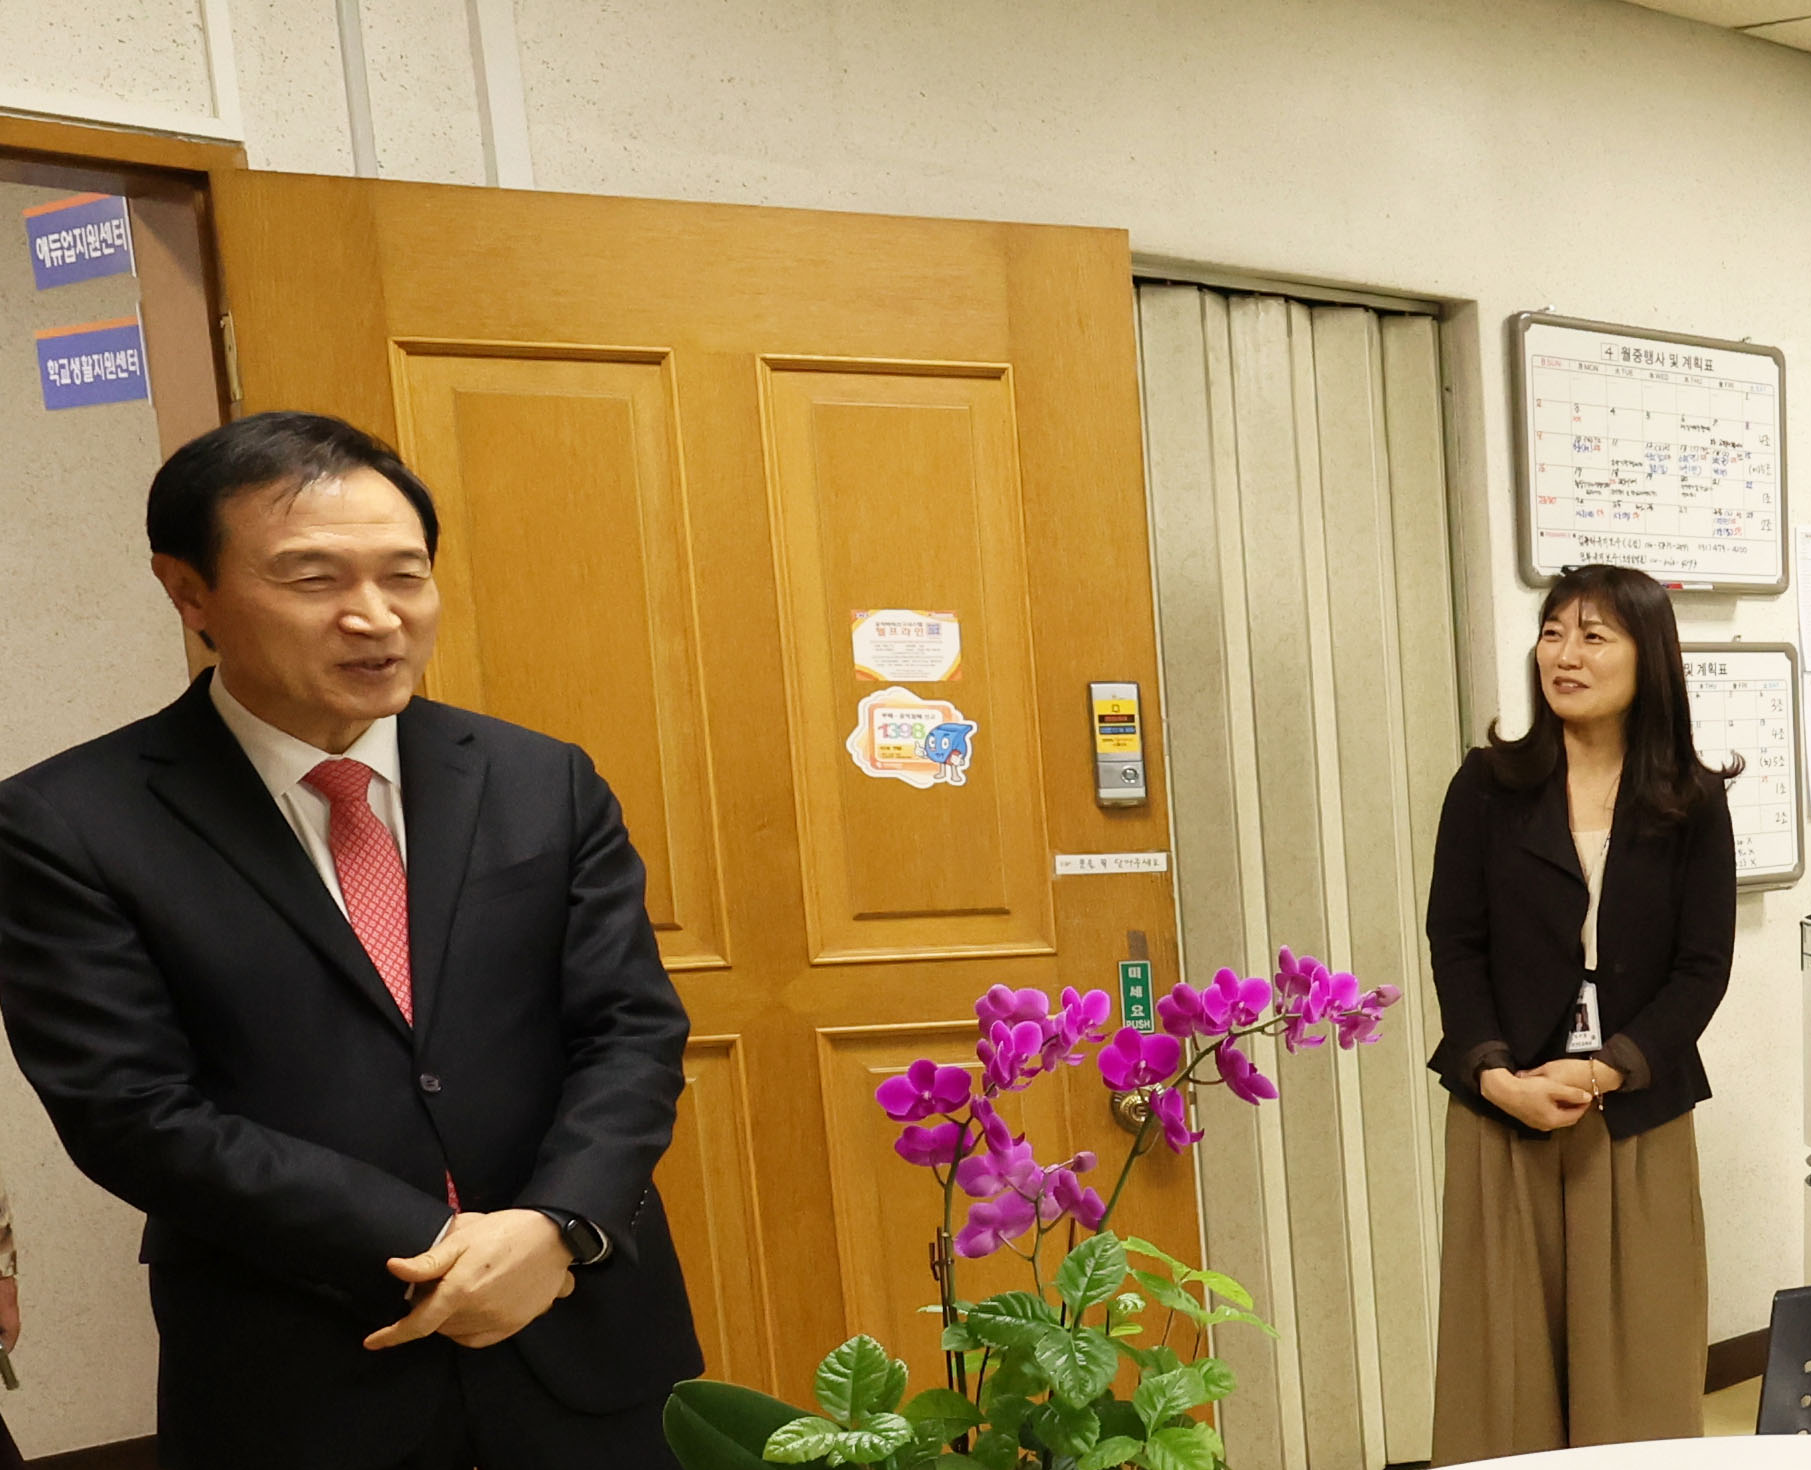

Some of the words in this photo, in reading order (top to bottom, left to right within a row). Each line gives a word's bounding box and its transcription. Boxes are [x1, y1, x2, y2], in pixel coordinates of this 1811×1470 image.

[47, 348, 141, 386] 학교생활지원센터
[1682, 355, 1714, 372] 계획표
[1697, 662, 1728, 676] 계획표
[878, 722, 926, 740] 1398
[1127, 966, 1146, 1017] 미세요
